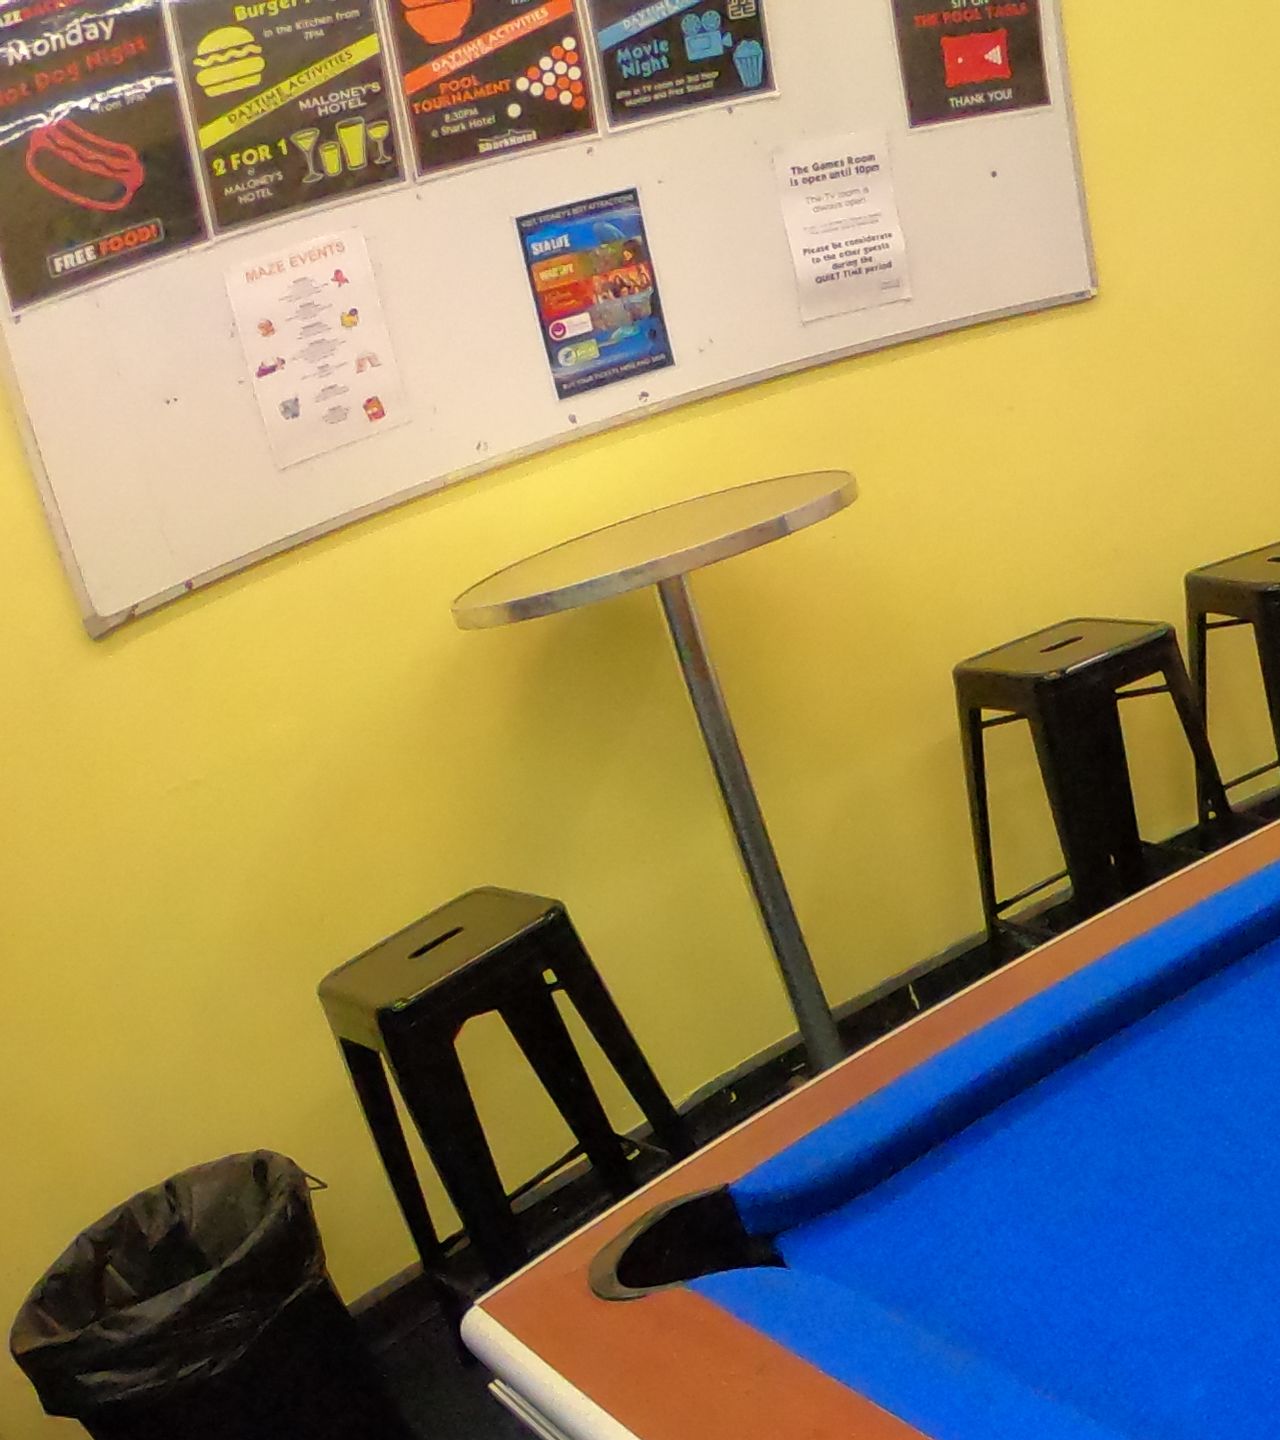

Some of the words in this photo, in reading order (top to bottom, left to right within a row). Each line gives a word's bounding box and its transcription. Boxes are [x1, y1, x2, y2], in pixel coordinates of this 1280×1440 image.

[335, 9, 360, 21] from
[488, 7, 549, 46] ACTIVITIES
[942, 8, 982, 24] POOL
[6, 17, 115, 66] Monday
[287, 51, 353, 92] ACTIVITIES
[621, 55, 671, 79] Night
[298, 81, 381, 111] MALONEY'S
[318, 98, 368, 117] HOTEL
[412, 79, 511, 115] TOURNAMENT
[949, 95, 985, 108] THANK
[987, 88, 1013, 102] YOU!
[468, 115, 497, 129] Hotel
[229, 144, 273, 172] FOR
[790, 165, 809, 175] The
[811, 160, 845, 172] Games
[846, 154, 876, 165] Room
[224, 171, 284, 196] MALONEY'S
[790, 178, 799, 187] is
[801, 174, 827, 185] open
[829, 167, 852, 180] until
[855, 164, 880, 174] 10pm
[237, 188, 274, 205] HOTEL
[53, 244, 97, 273] FREE
[98, 223, 160, 256] FOOD!
[802, 244, 830, 256] Please
[844, 232, 893, 247] considerate
[838, 248, 861, 258] other
[862, 242, 890, 256] guests
[244, 259, 287, 284] MAZE
[288, 240, 346, 269] EVENTS
[815, 270, 841, 284] QUIET
[842, 266, 863, 278] TIME
[864, 260, 893, 275] period
[831, 259, 858, 270] during
